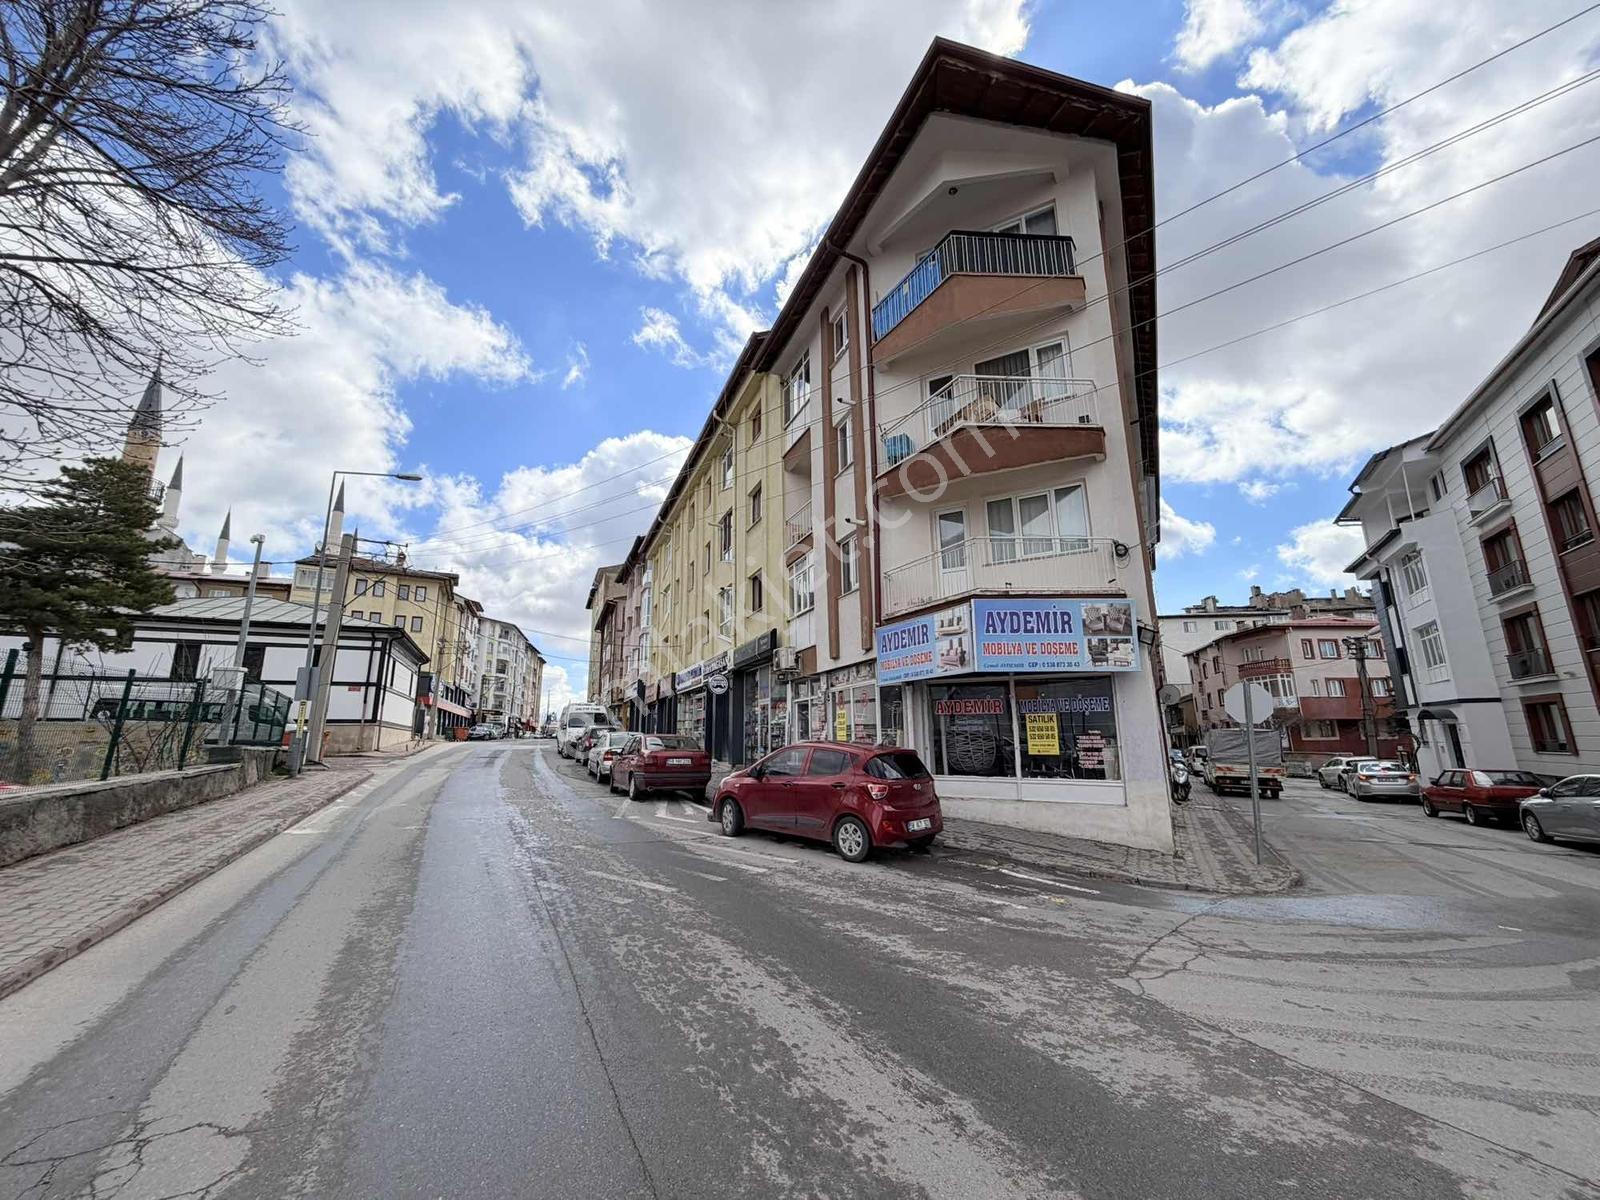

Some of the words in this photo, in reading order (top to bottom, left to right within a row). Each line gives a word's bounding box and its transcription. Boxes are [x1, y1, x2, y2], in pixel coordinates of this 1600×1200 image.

[984, 604, 1074, 634] AYDEMİR
[881, 620, 930, 653] AYDEMİR
[1025, 642, 1037, 655] VE
[935, 695, 1004, 715] AYDEMİR
[1058, 698, 1071, 713] VE
[1028, 715, 1055, 723] SATILIK
